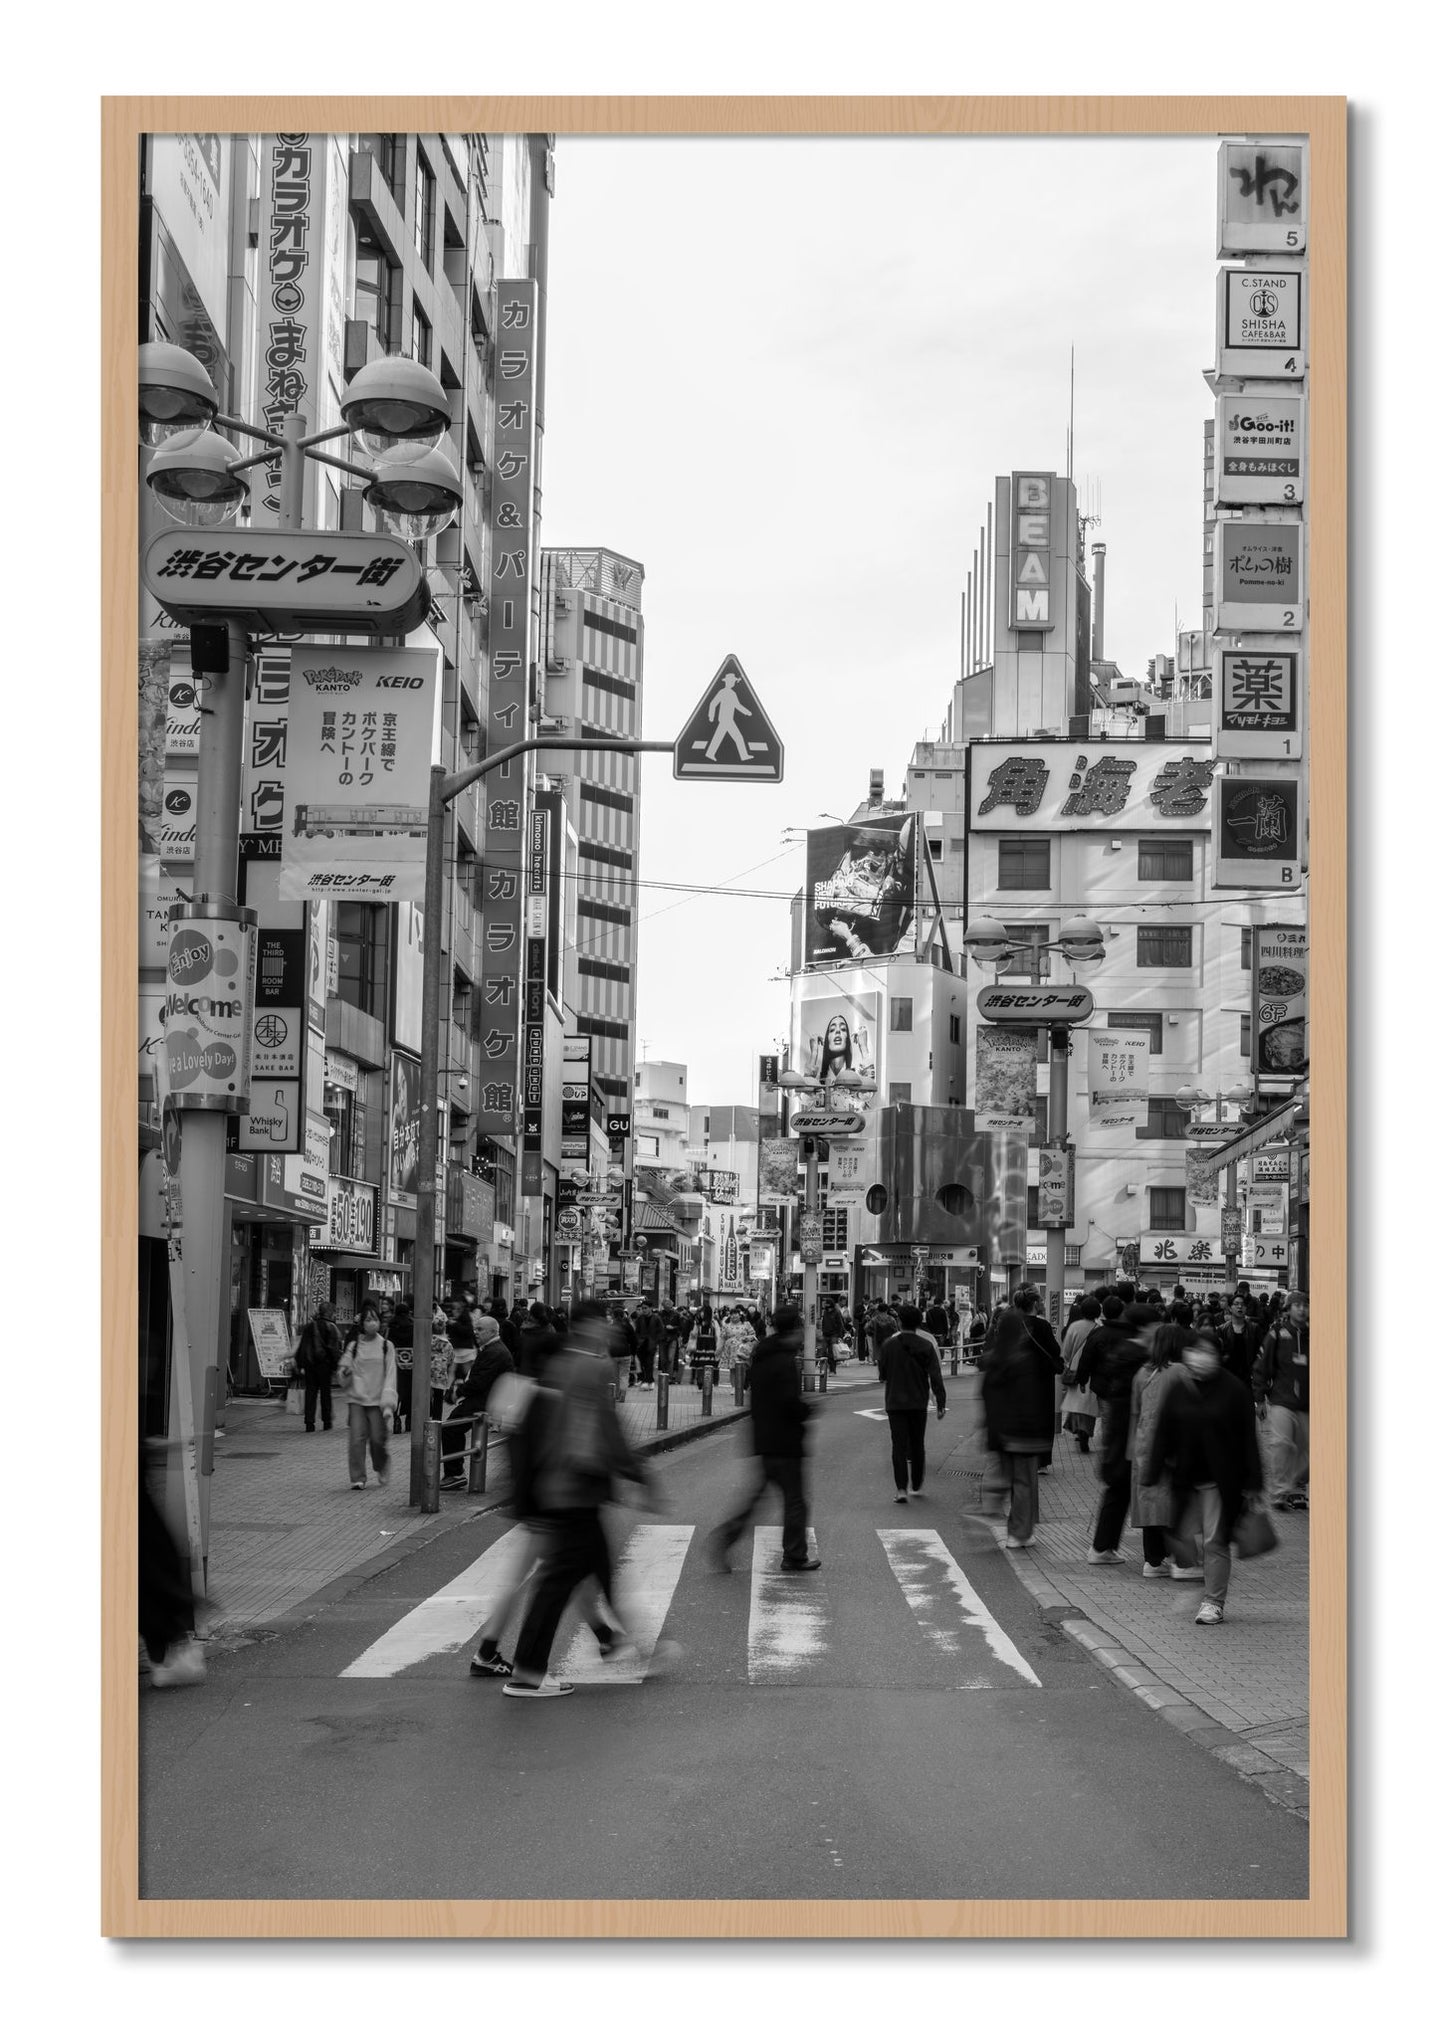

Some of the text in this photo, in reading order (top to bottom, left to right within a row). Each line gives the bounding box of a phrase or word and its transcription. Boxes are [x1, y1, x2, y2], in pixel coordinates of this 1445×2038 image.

[1286, 231, 1298, 246] 5
[1242, 279, 1287, 288] C.STAND
[1242, 319, 1286, 329] SHISHA
[1242, 330, 1286, 338] CAFE&BAR
[1228, 461, 1295, 473] 全身もみほぐし
[1283, 484, 1295, 500] 3
[1016, 478, 1049, 621] BEAM
[157, 549, 405, 587] 渋谷センター街
[1283, 611, 1294, 626] 2
[376, 676, 424, 689] KEIO
[1233, 659, 1282, 710] 薬
[1227, 714, 1288, 727] マツモトキヨシ
[320, 711, 336, 754] 冒険へ
[339, 711, 356, 786] カントーの
[359, 711, 378, 786] ポケパーク
[381, 713, 397, 772] 京王線で
[1283, 739, 1291, 754] 1
[978, 757, 1217, 816] 角海老
[1227, 794, 1287, 843] 一蘭
[533, 815, 543, 889] kimono hearts
[308, 874, 396, 887] 渋谷センター街
[1282, 867, 1293, 882] B
[170, 943, 210, 977] Enjoy
[262, 977, 284, 985] ROOM
[265, 987, 280, 995] BAR
[166, 993, 243, 1019] Welcome
[985, 994, 1087, 1008] 渋谷センター街
[1259, 1004, 1288, 1023] 6F
[183, 1051, 213, 1071] Lovely
[215, 1052, 235, 1066] Day!
[250, 1116, 283, 1127] Whisky
[609, 1120, 629, 1131] GU
[249, 1126, 269, 1134] Bank
[727, 1237, 736, 1280] BEER
